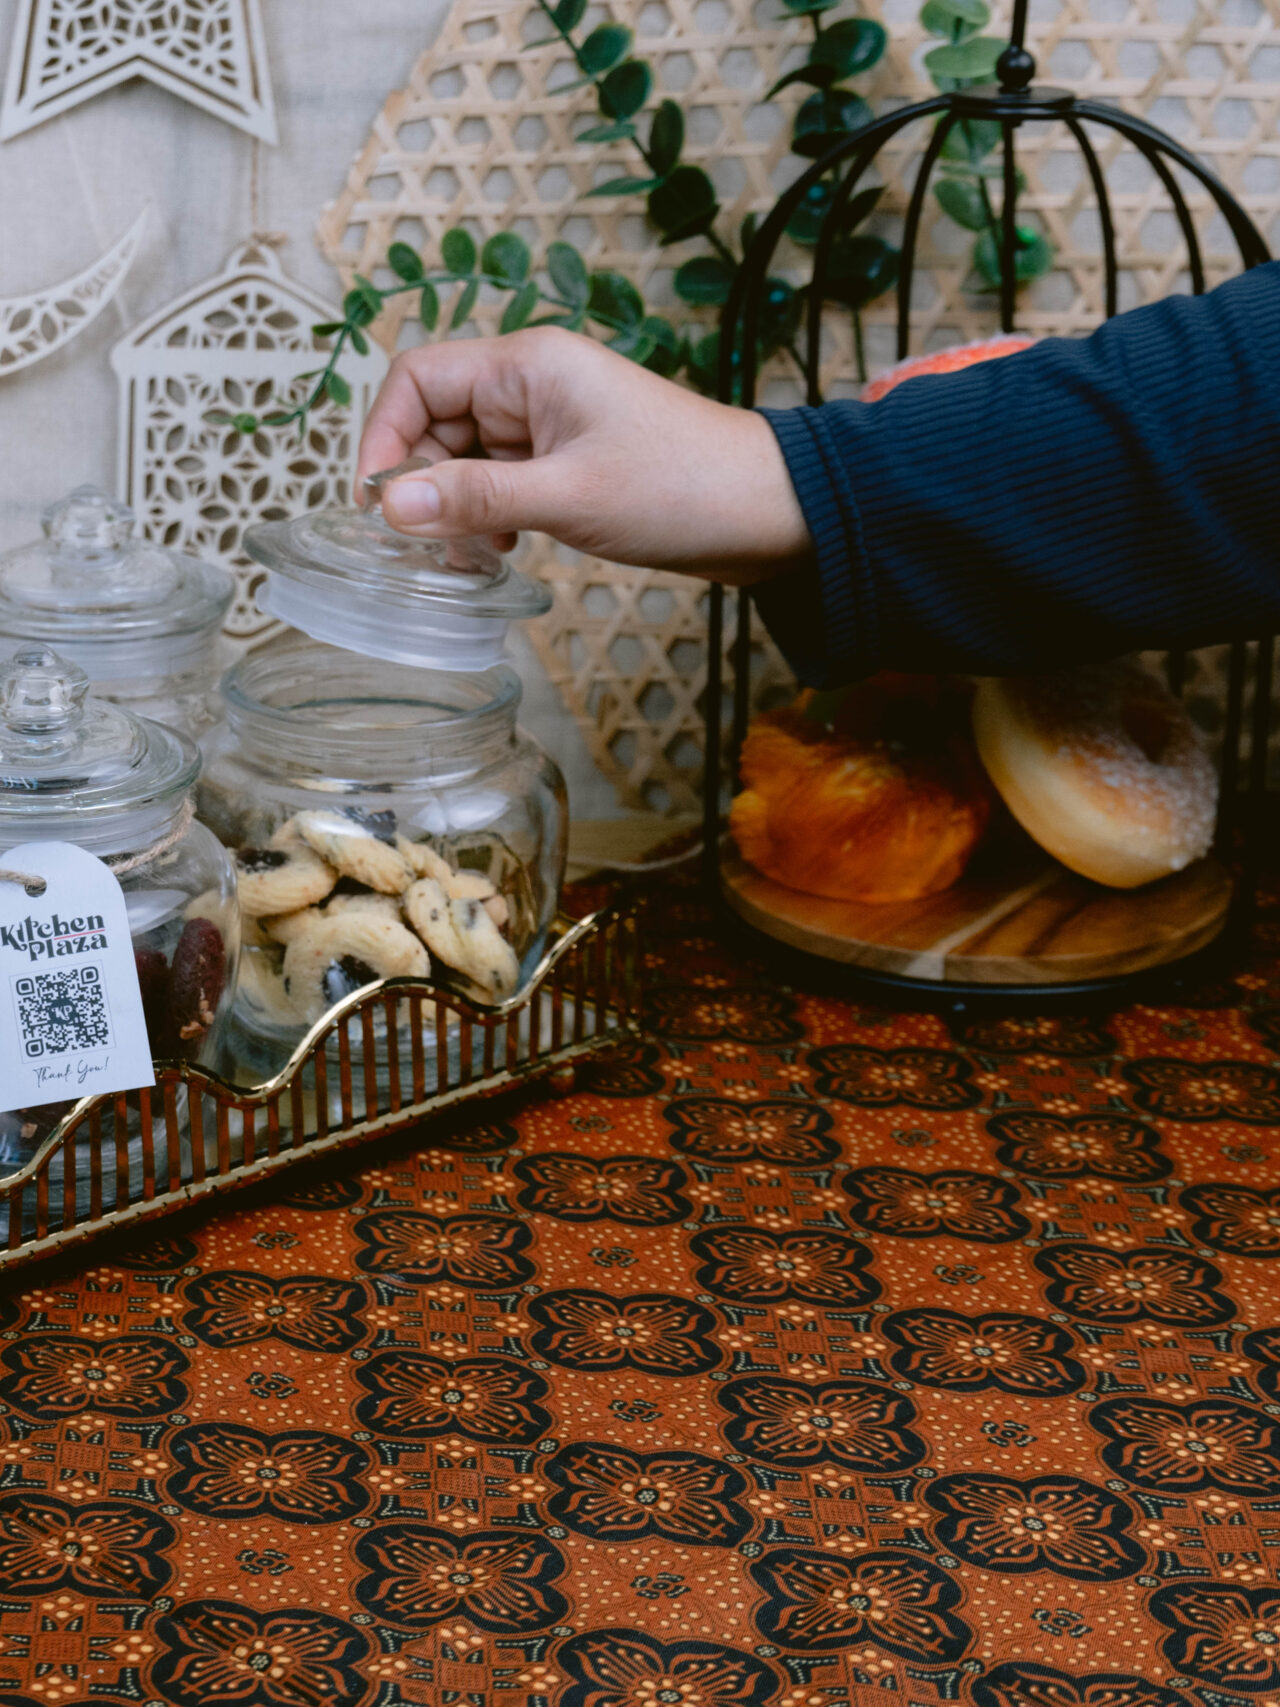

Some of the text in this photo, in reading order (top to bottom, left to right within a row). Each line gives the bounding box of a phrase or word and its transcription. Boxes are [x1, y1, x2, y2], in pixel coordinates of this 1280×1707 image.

[28, 933, 108, 961] Plaza
[51, 1005, 73, 1020] KP
[32, 1056, 109, 1088] Thank You!
